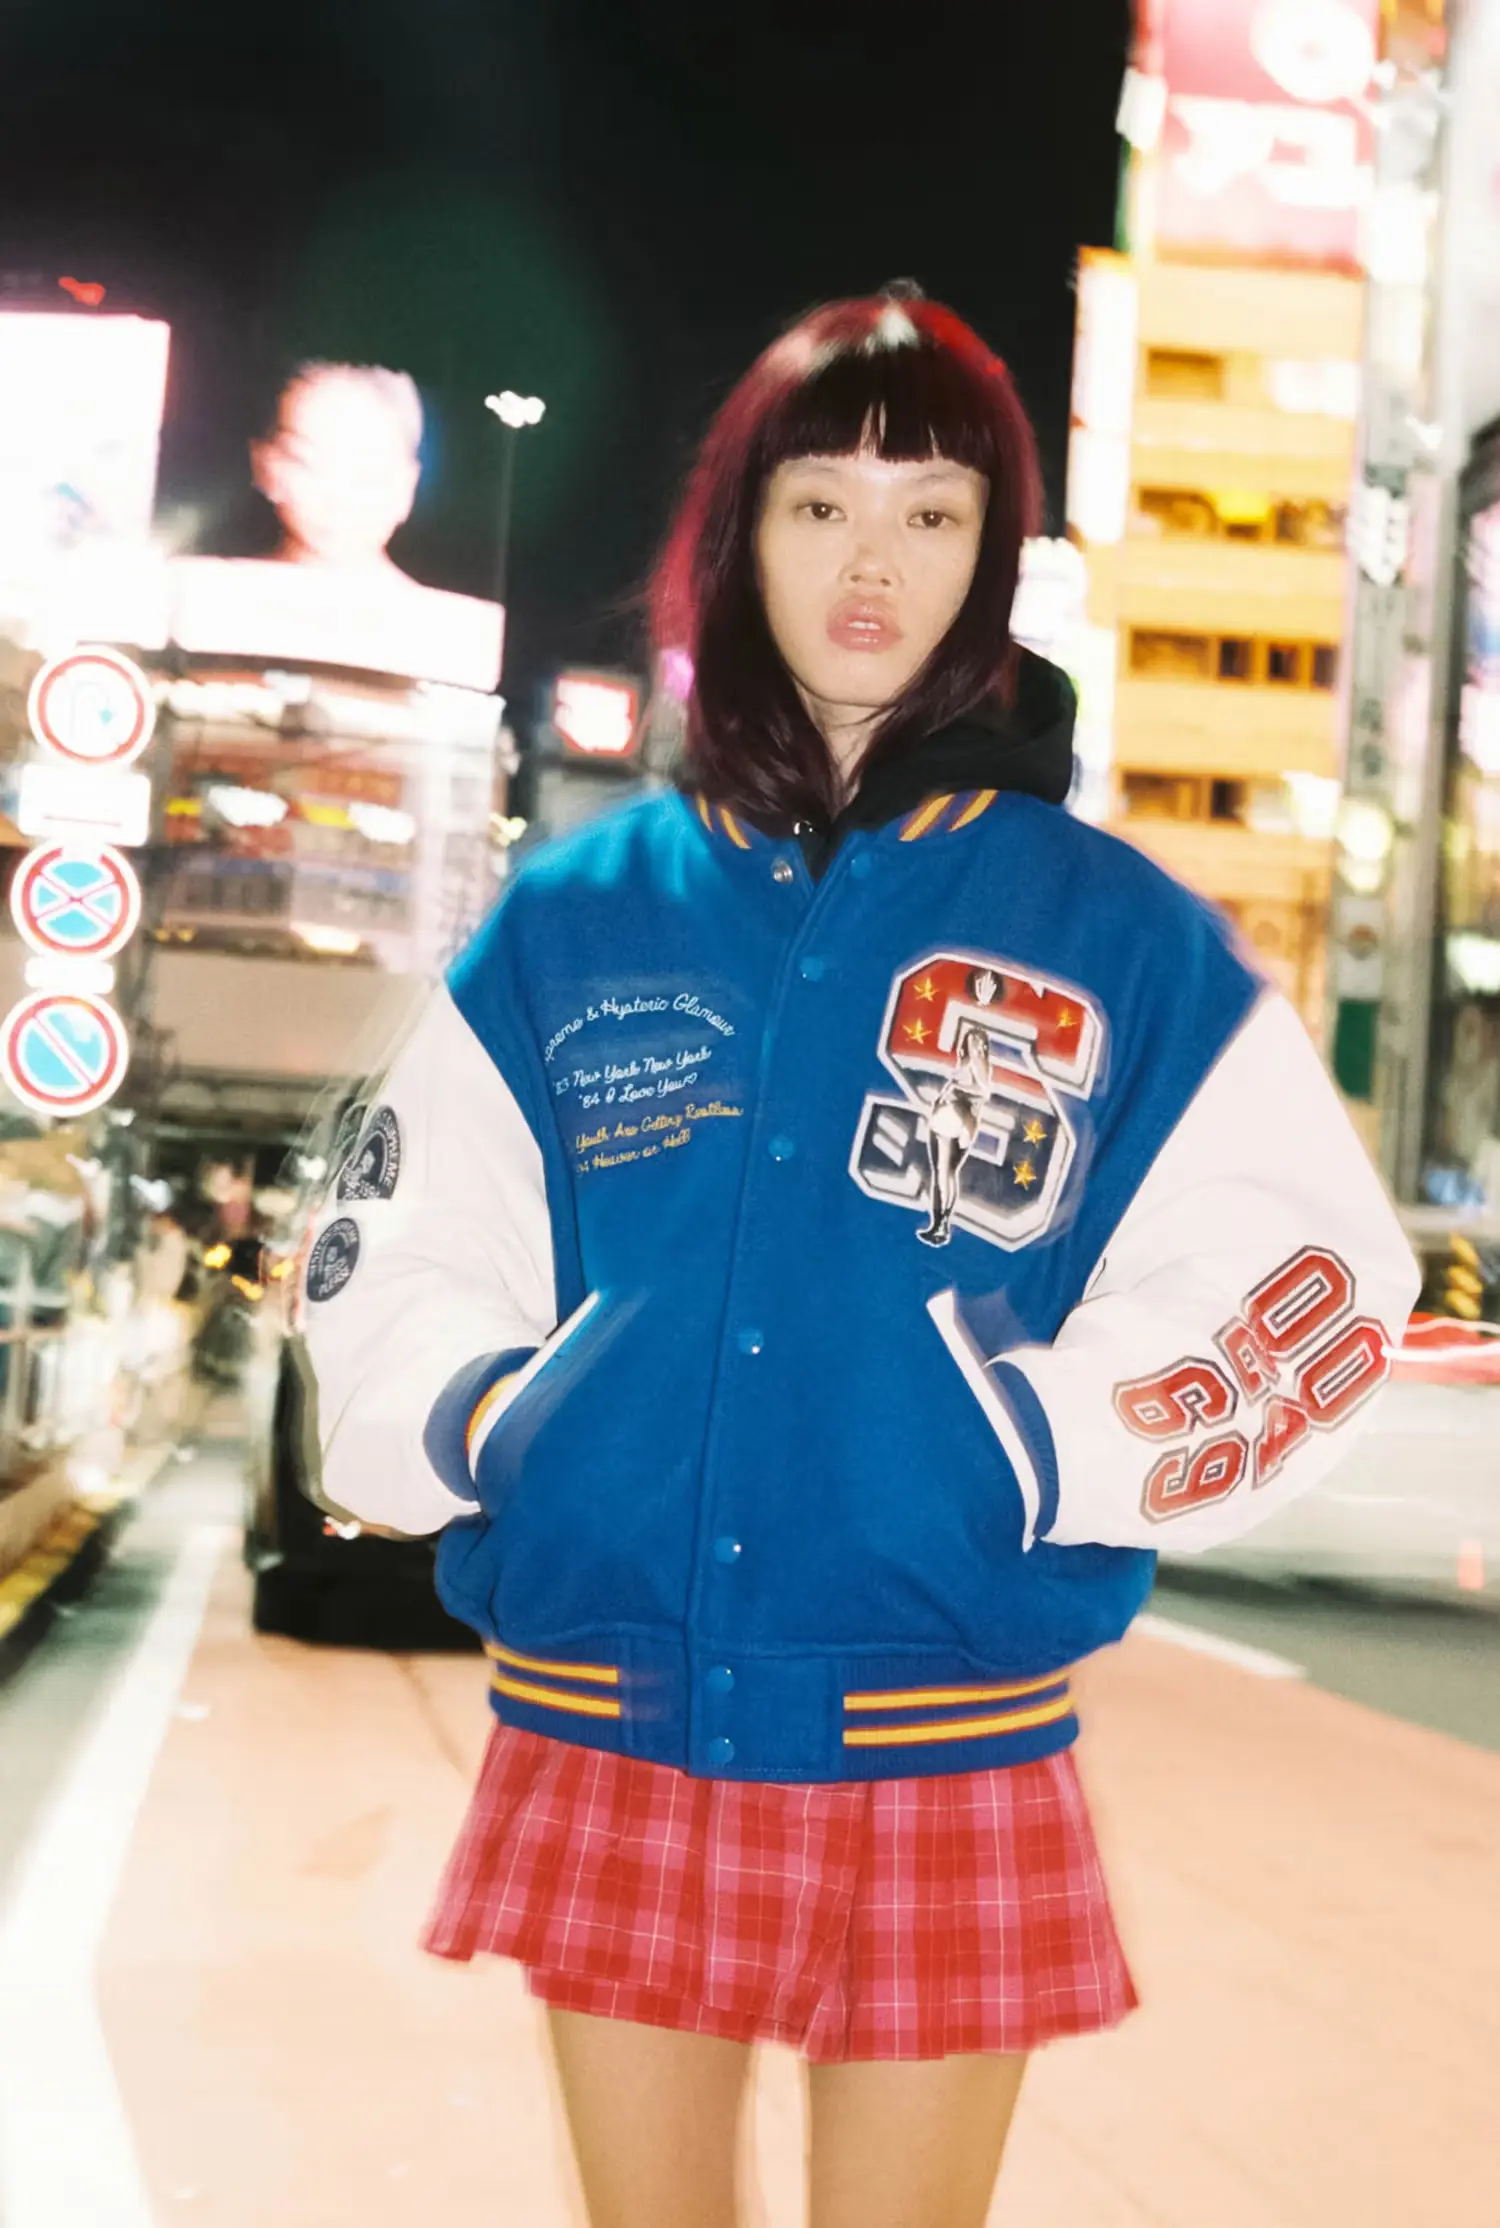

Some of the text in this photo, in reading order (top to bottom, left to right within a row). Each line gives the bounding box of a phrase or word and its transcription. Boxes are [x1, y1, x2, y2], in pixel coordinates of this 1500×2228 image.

[586, 1006, 600, 1022] &
[600, 997, 670, 1021] Hysteric
[673, 992, 736, 1036] Glamour
[573, 1069, 601, 1088] New
[604, 1060, 641, 1084] York
[642, 1056, 674, 1075] New
[676, 1045, 713, 1071] York
[618, 1083, 656, 1103] Love
[657, 1078, 686, 1098] You
